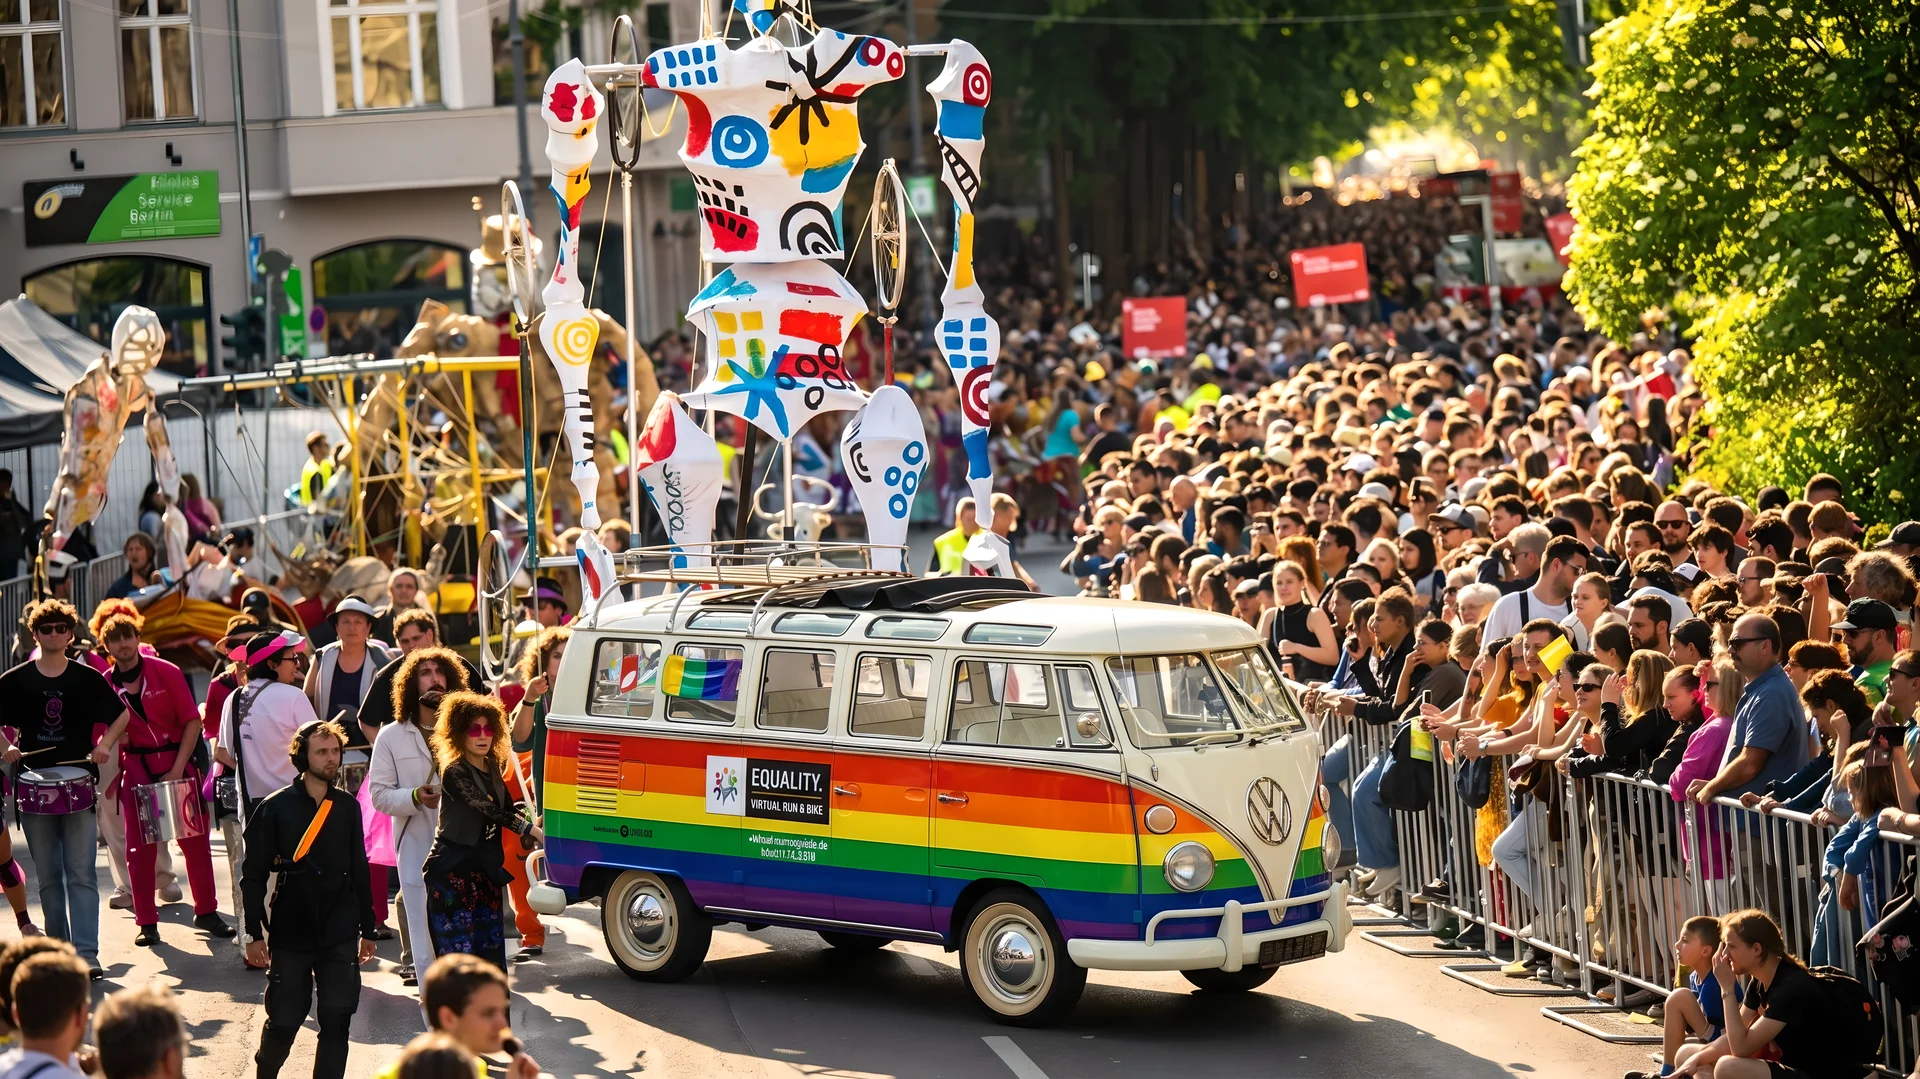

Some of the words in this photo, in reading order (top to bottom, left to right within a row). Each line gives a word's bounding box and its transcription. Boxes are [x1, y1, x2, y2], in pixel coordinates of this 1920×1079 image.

[751, 767, 823, 793] EQUALITY.
[750, 798, 782, 812] VIRTUAL
[782, 801, 798, 813] RUN
[799, 803, 805, 814] &
[806, 804, 824, 816] BIKE
